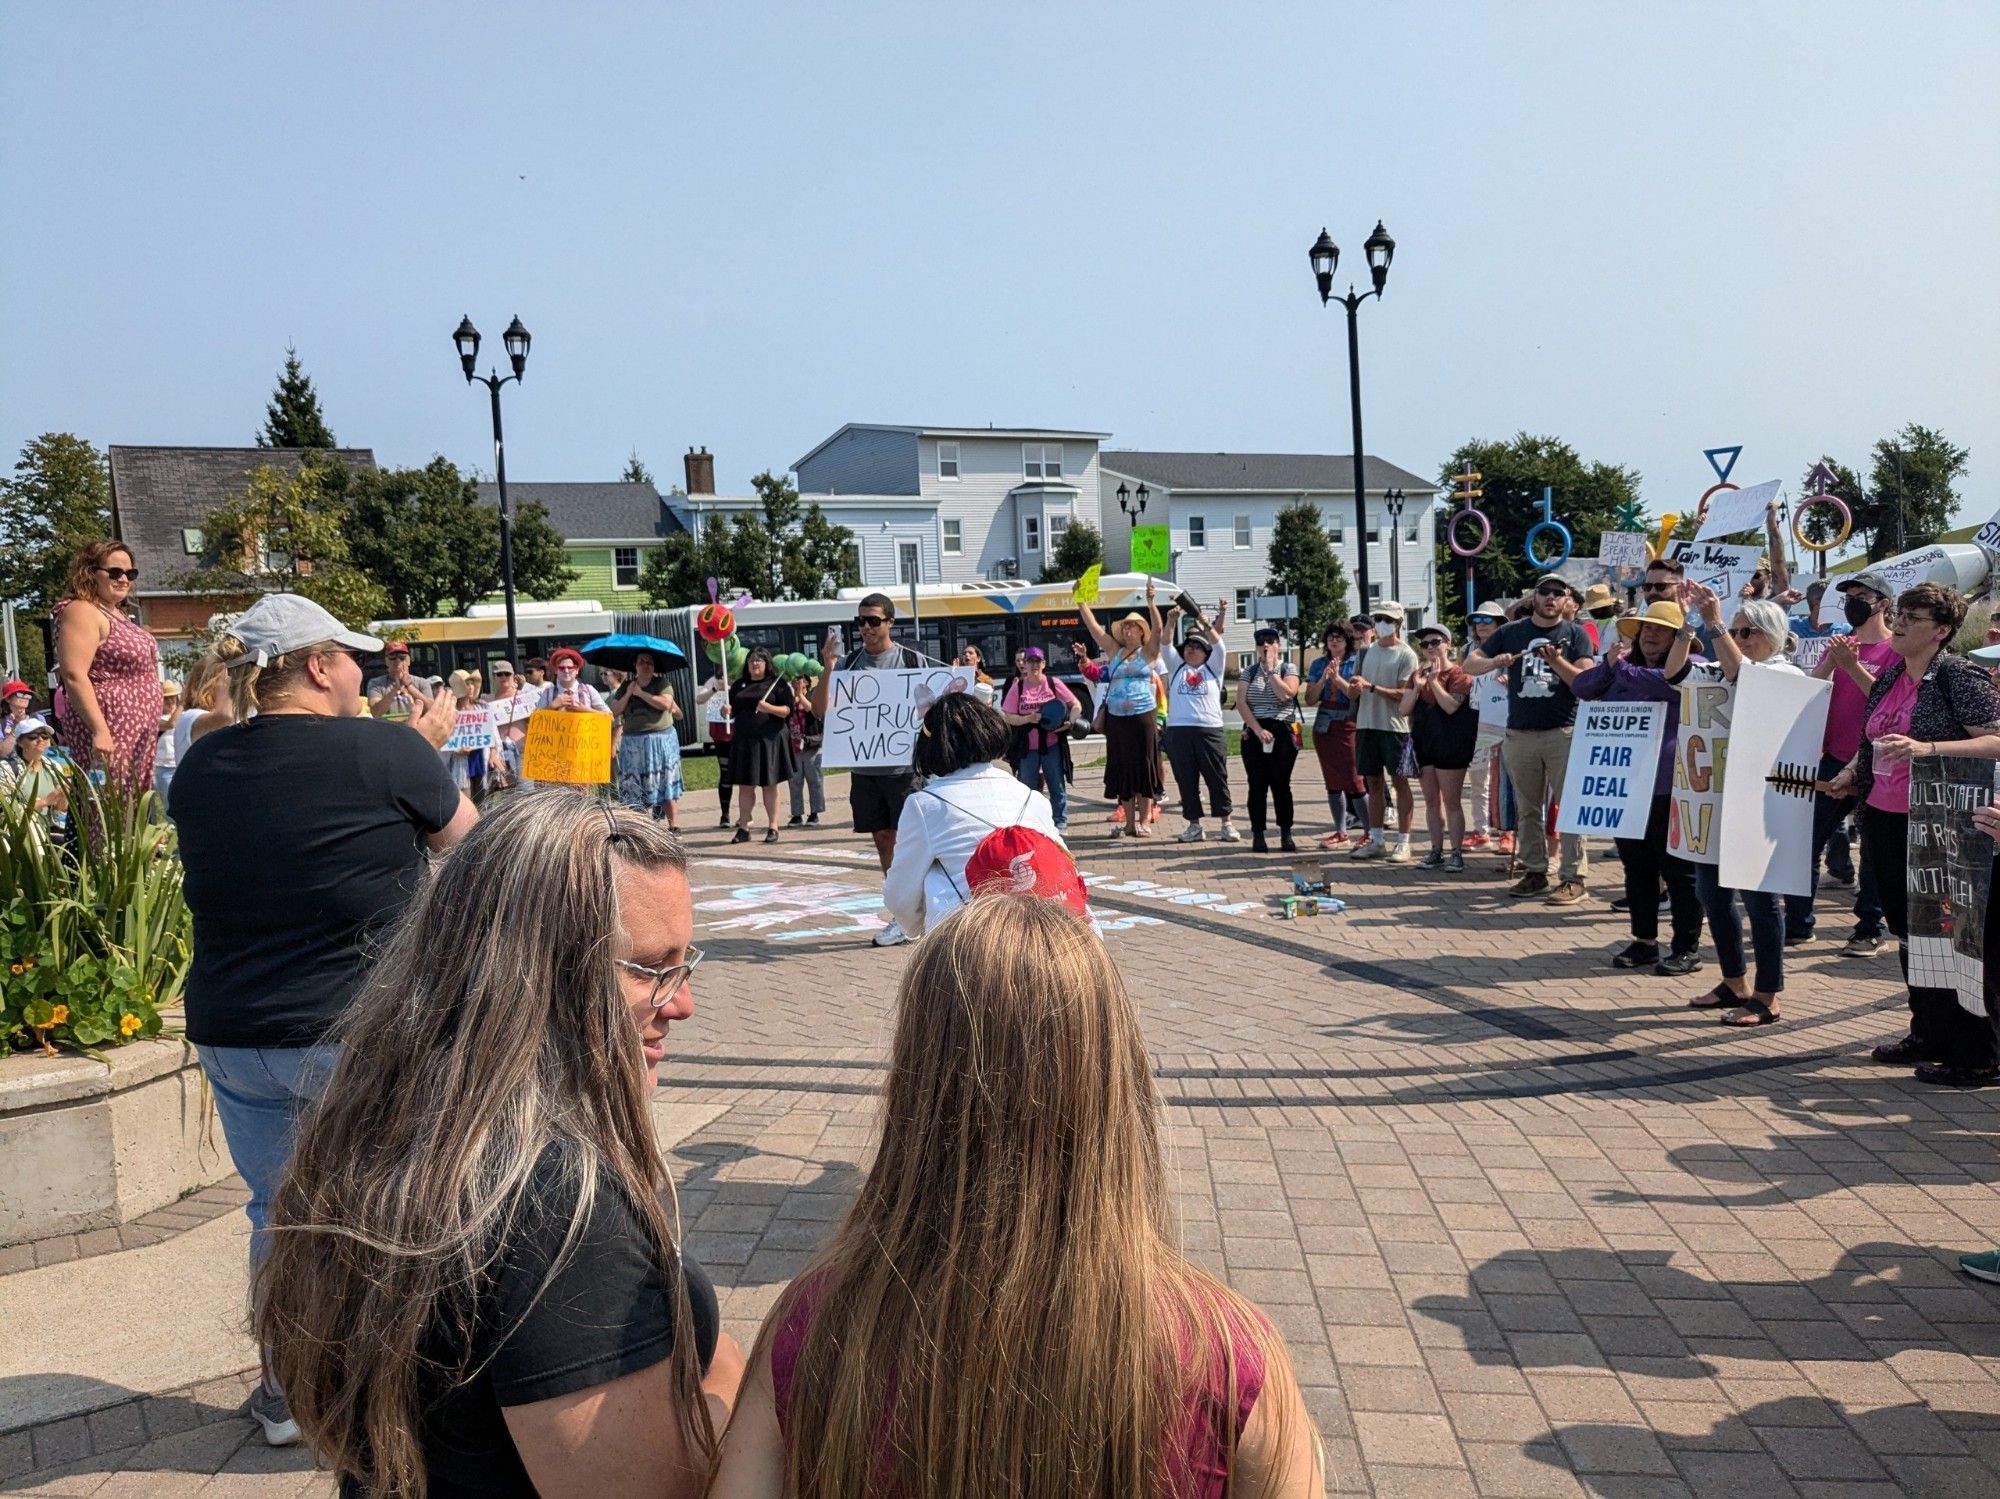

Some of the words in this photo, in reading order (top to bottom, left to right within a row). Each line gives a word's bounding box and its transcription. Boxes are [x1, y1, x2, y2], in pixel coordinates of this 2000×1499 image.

[1604, 532, 1634, 543] TIME
[1602, 545, 1631, 557] SPEAK
[1632, 546, 1646, 557] UP
[1672, 541, 1700, 564] Fair
[1704, 546, 1741, 569] Wages
[1059, 618, 1079, 626] SERVICE
[834, 674, 880, 707] NO
[455, 711, 488, 724] VERDUE
[532, 713, 566, 732] PAYING
[1586, 715, 1651, 731] NSUPE
[447, 734, 491, 749] WAGES
[529, 732, 553, 746] THAN
[558, 735, 565, 748] A
[567, 735, 599, 750] LIVING
[529, 747, 562, 761] WAGE
[1589, 746, 1632, 767] FAIR
[1581, 775, 1628, 798] DEAL
[1576, 806, 1624, 828] NOW
